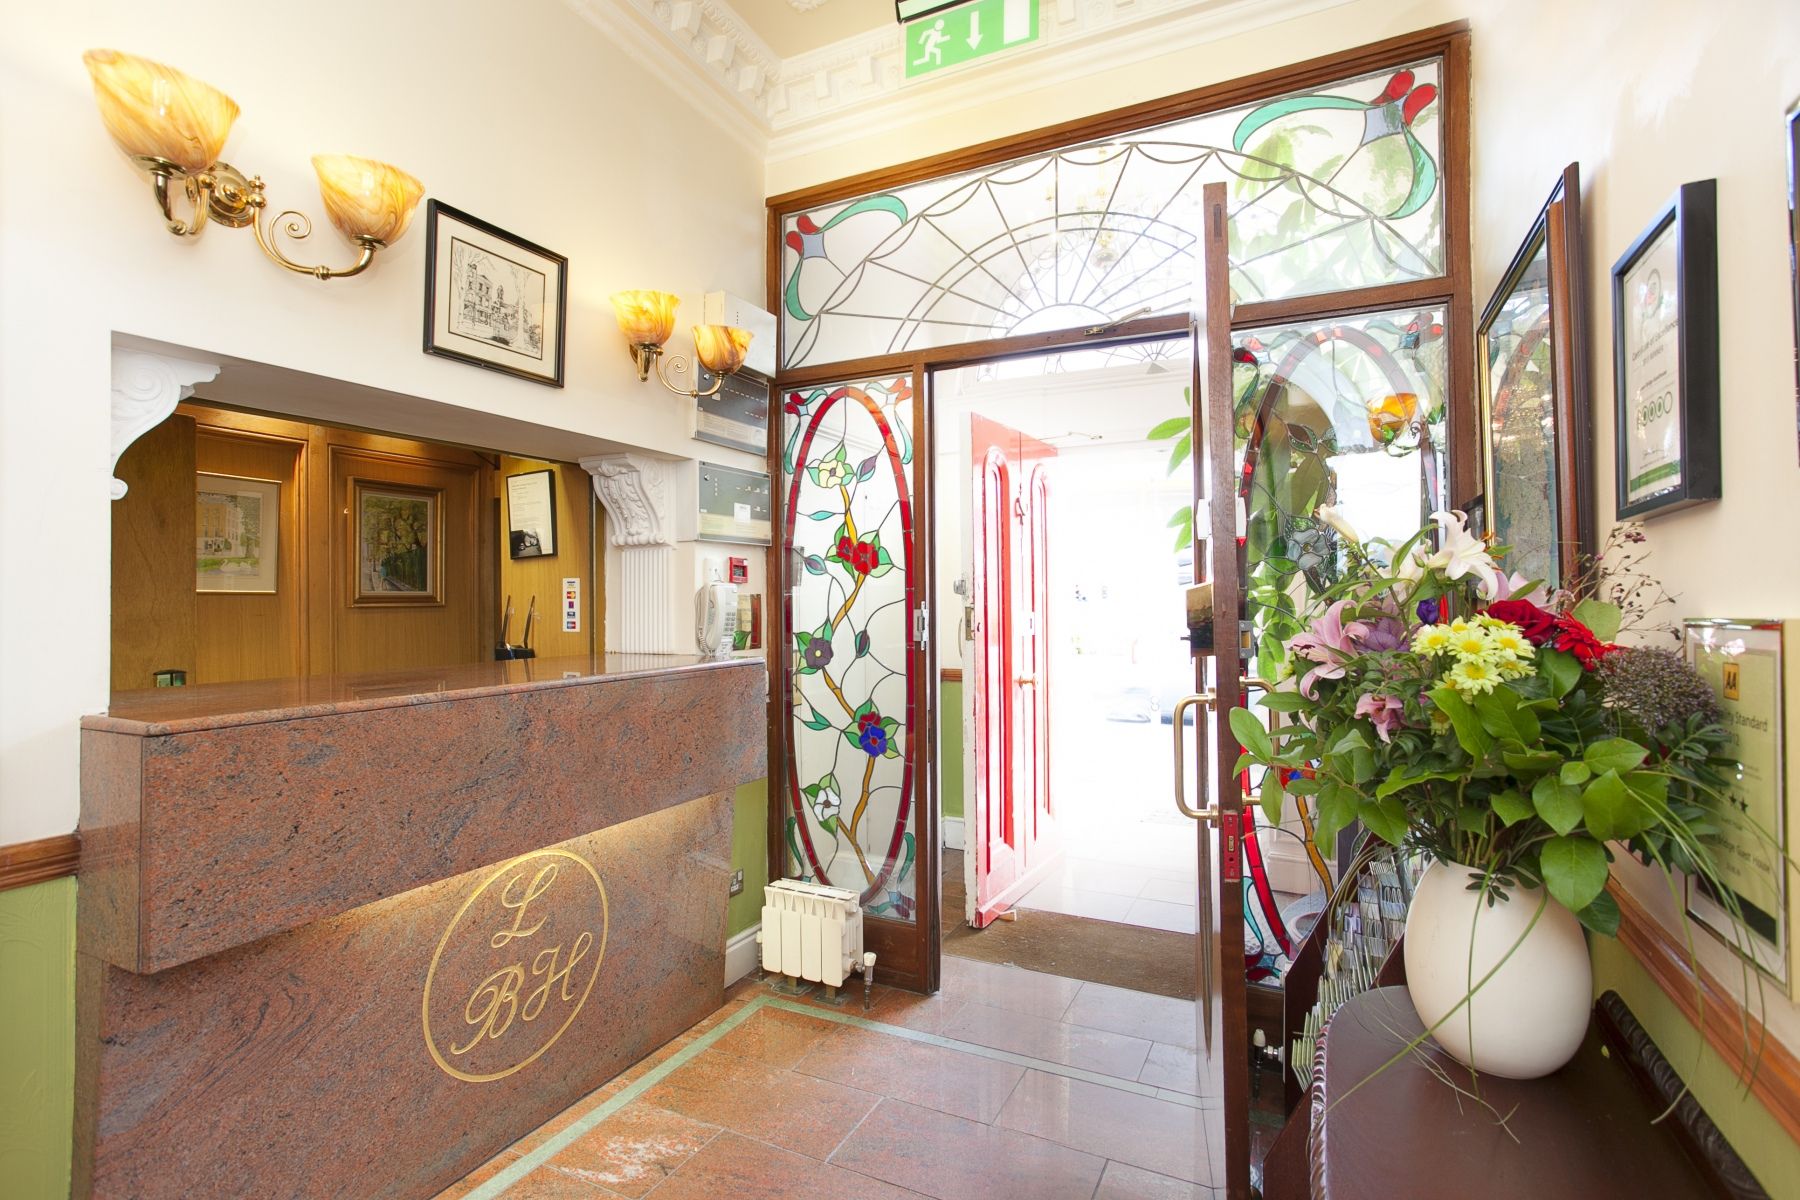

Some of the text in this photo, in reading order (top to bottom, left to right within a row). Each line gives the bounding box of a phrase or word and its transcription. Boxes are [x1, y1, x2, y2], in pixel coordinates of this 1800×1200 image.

[1725, 671, 1737, 690] AA
[1735, 712, 1768, 733] Standard
[491, 863, 559, 948] L
